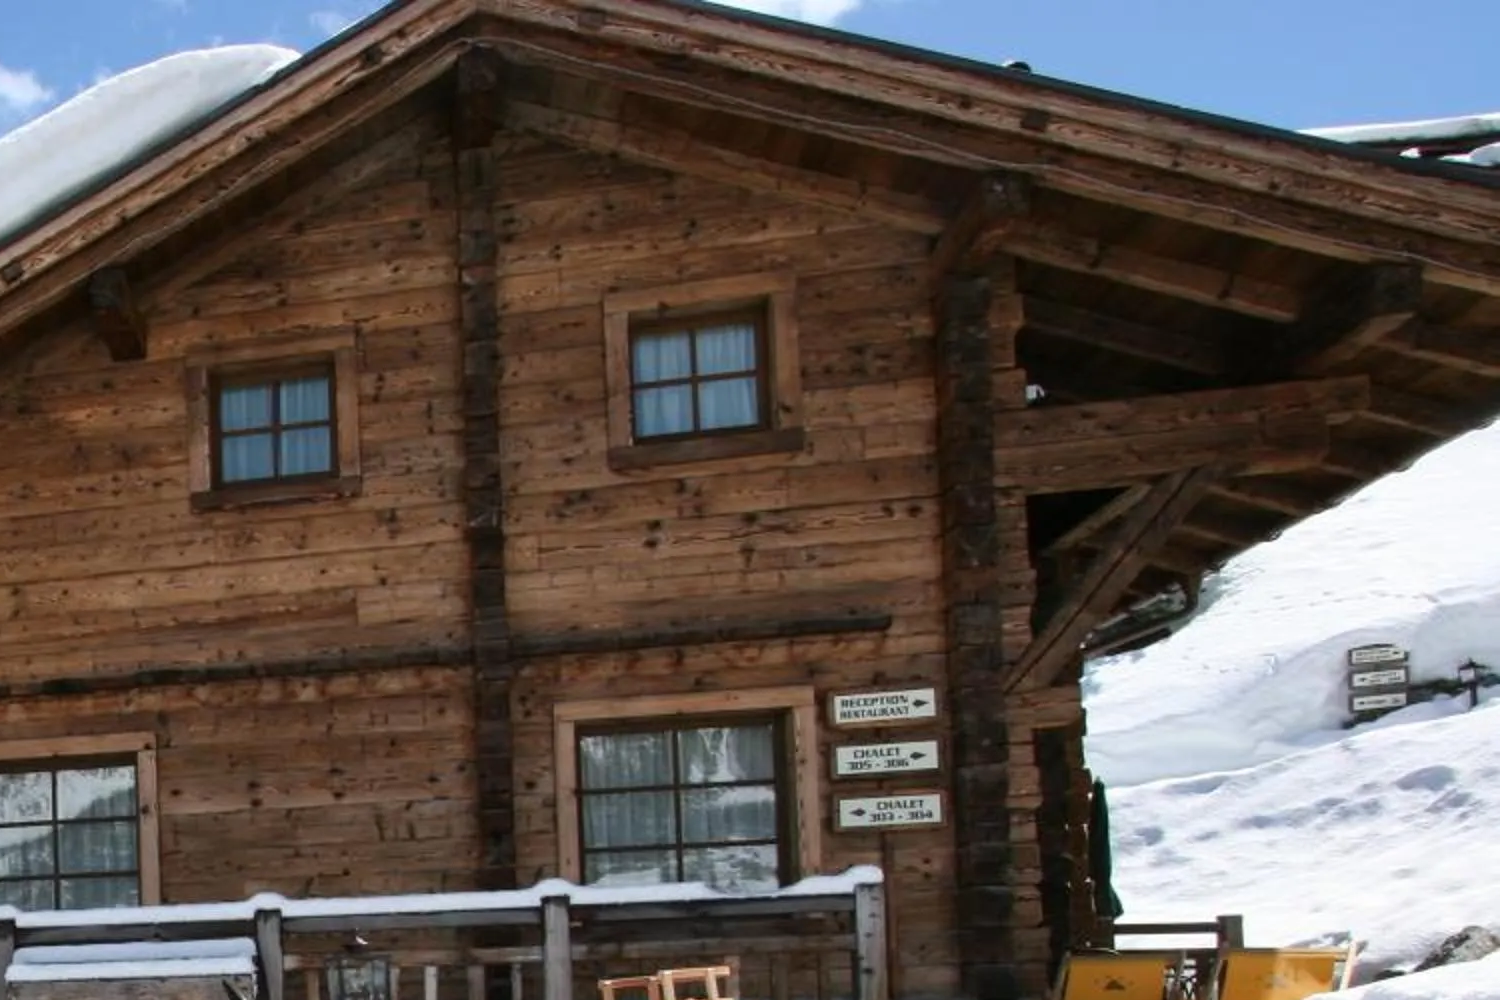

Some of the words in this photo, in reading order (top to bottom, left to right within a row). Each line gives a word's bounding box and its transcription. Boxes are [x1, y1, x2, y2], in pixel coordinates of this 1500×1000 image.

[840, 695, 909, 708] RECEPTION
[840, 706, 910, 719] RESTAURANT
[853, 747, 901, 759] CHALET
[876, 800, 925, 811] CHALET
